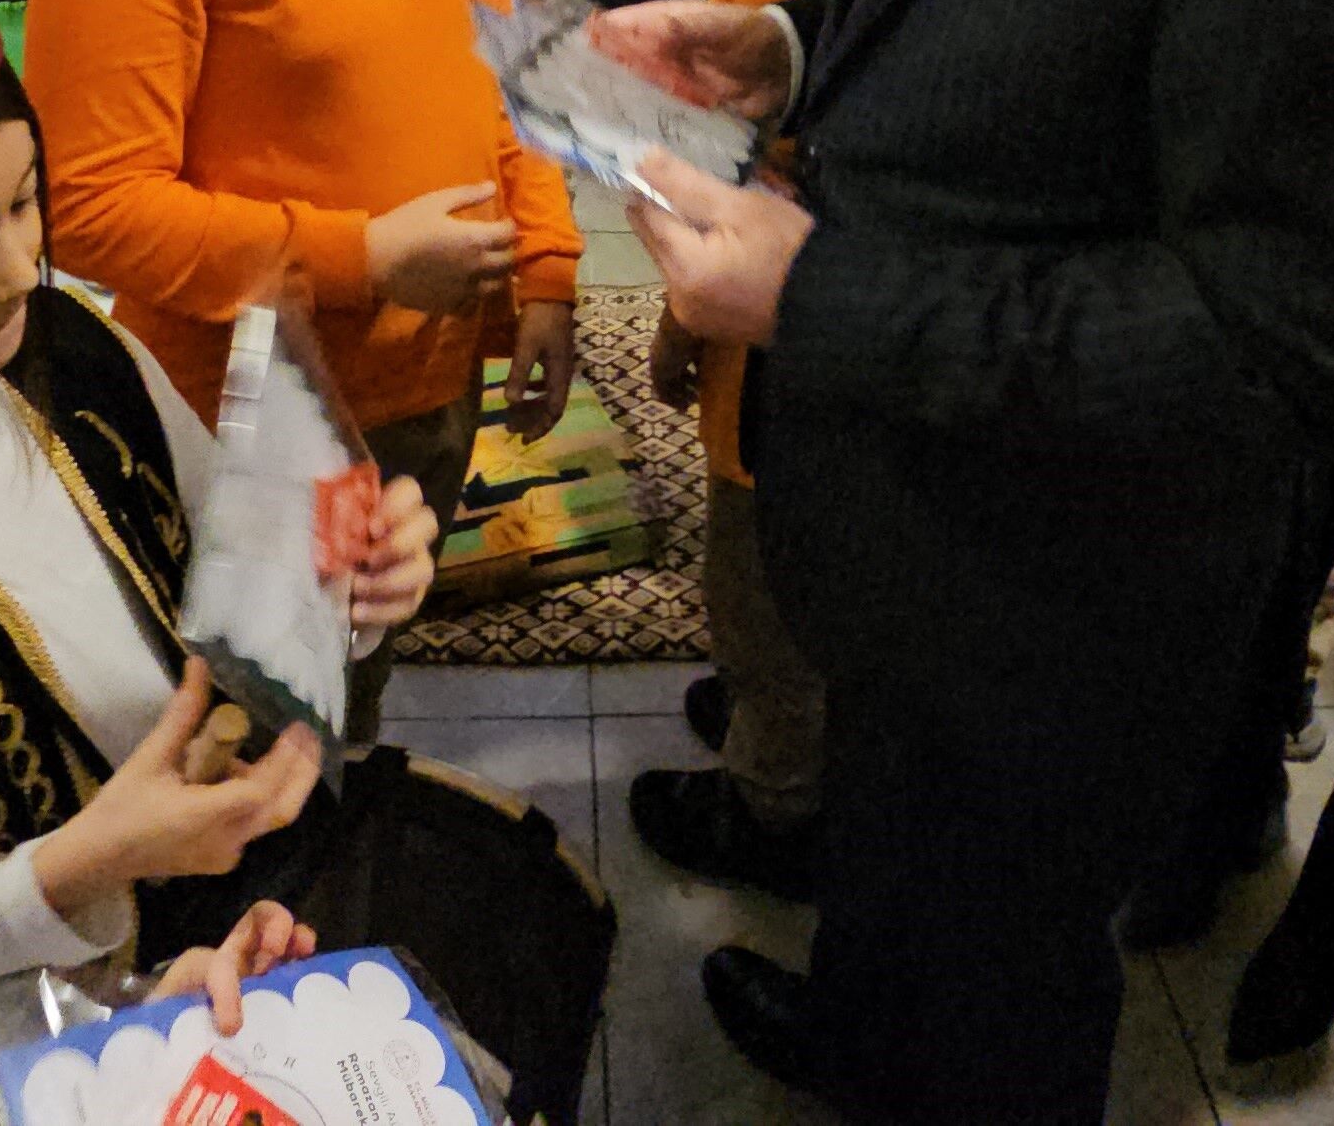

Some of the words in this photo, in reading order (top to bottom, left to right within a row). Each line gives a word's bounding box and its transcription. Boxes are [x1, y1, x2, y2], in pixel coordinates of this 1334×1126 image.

[336, 1060, 369, 1126] Mübarek
[347, 1052, 380, 1123] Ramazan
[366, 1060, 390, 1108] Sevgili
